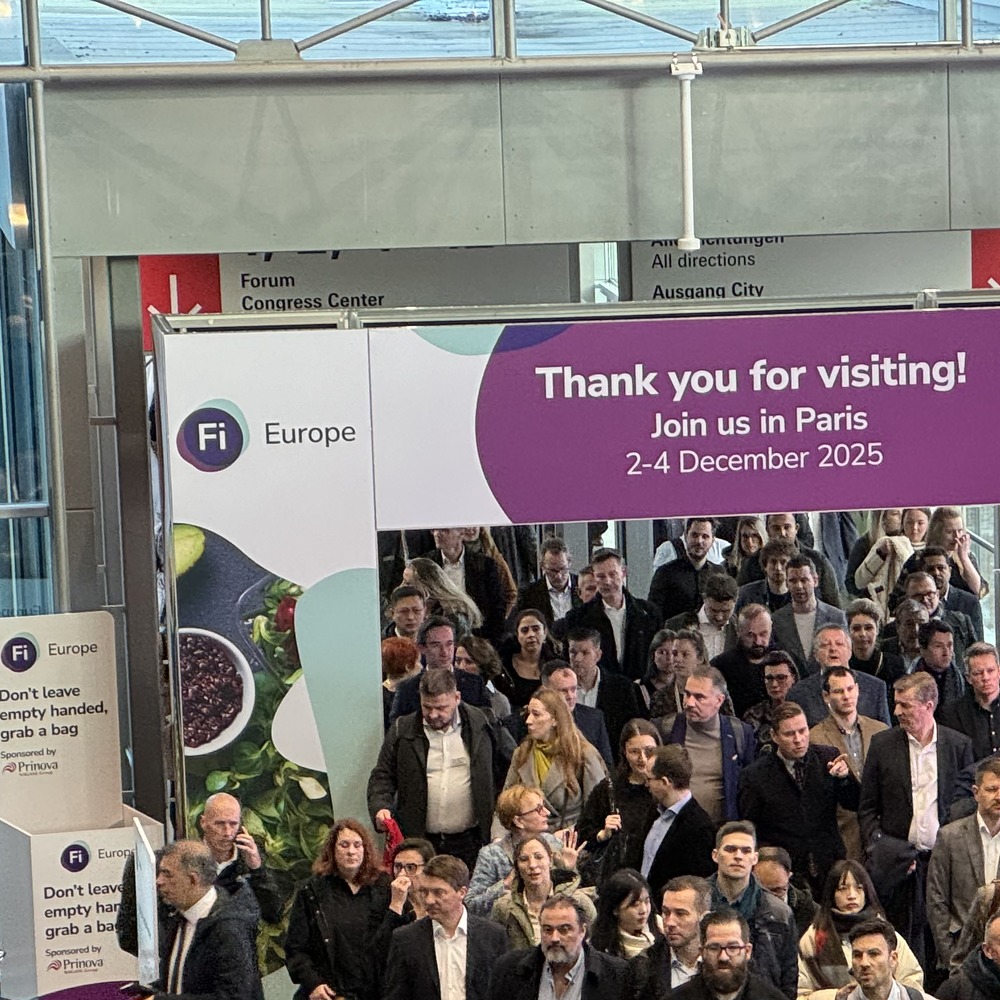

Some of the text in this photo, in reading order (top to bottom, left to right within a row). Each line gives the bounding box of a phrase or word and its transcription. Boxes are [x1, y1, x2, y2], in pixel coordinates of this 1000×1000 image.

[651, 252, 756, 269] All directions
[241, 273, 295, 288] Forum
[652, 281, 764, 299] Ausgang City
[242, 292, 385, 312] Congress Center
[534, 351, 967, 401] Thank you for visiting!
[650, 404, 869, 438] Join us in Paris
[197, 422, 357, 451] Fi Europe
[625, 442, 884, 475] 2-4 December 2025
[12, 643, 98, 661] Fi Europe
[0, 686, 81, 702] Don't leave
[0, 701, 108, 722] empty handed,
[0, 723, 78, 742] grab a bag
[0, 747, 57, 760] Sponsored by
[18, 761, 58, 772] Prinova
[69, 850, 83, 864] Fi
[44, 885, 84, 899] Don't
[44, 904, 91, 919] empty
[45, 923, 79, 940] grab
[83, 924, 92, 934] a
[45, 945, 102, 958] Sponsored by
[63, 958, 104, 969] Prinova
